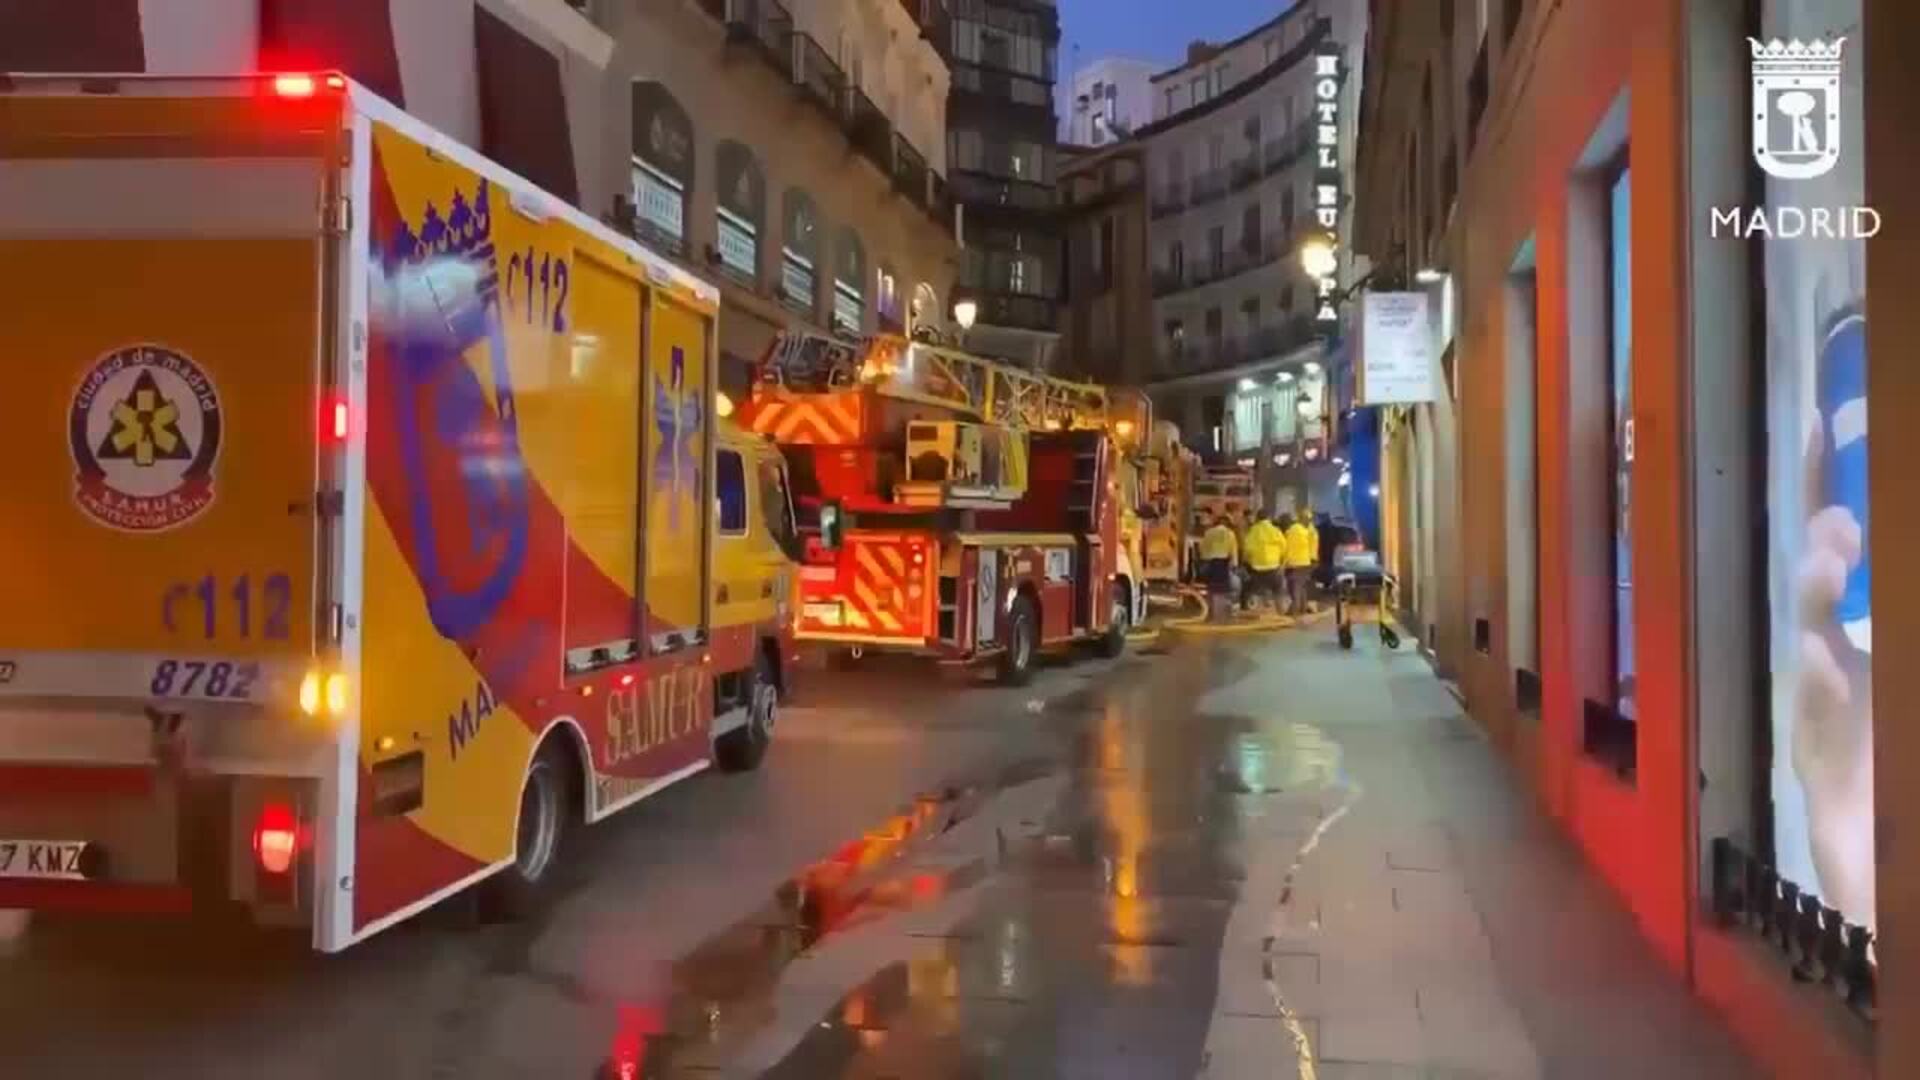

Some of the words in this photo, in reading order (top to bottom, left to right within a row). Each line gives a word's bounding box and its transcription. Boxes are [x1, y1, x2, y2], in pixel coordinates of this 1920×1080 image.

[1316, 55, 1338, 168] HOTEL
[1317, 185, 1338, 321] EUPA
[132, 348, 155, 363] de
[151, 660, 256, 697] 8782
[28, 845, 80, 873] KMZ
